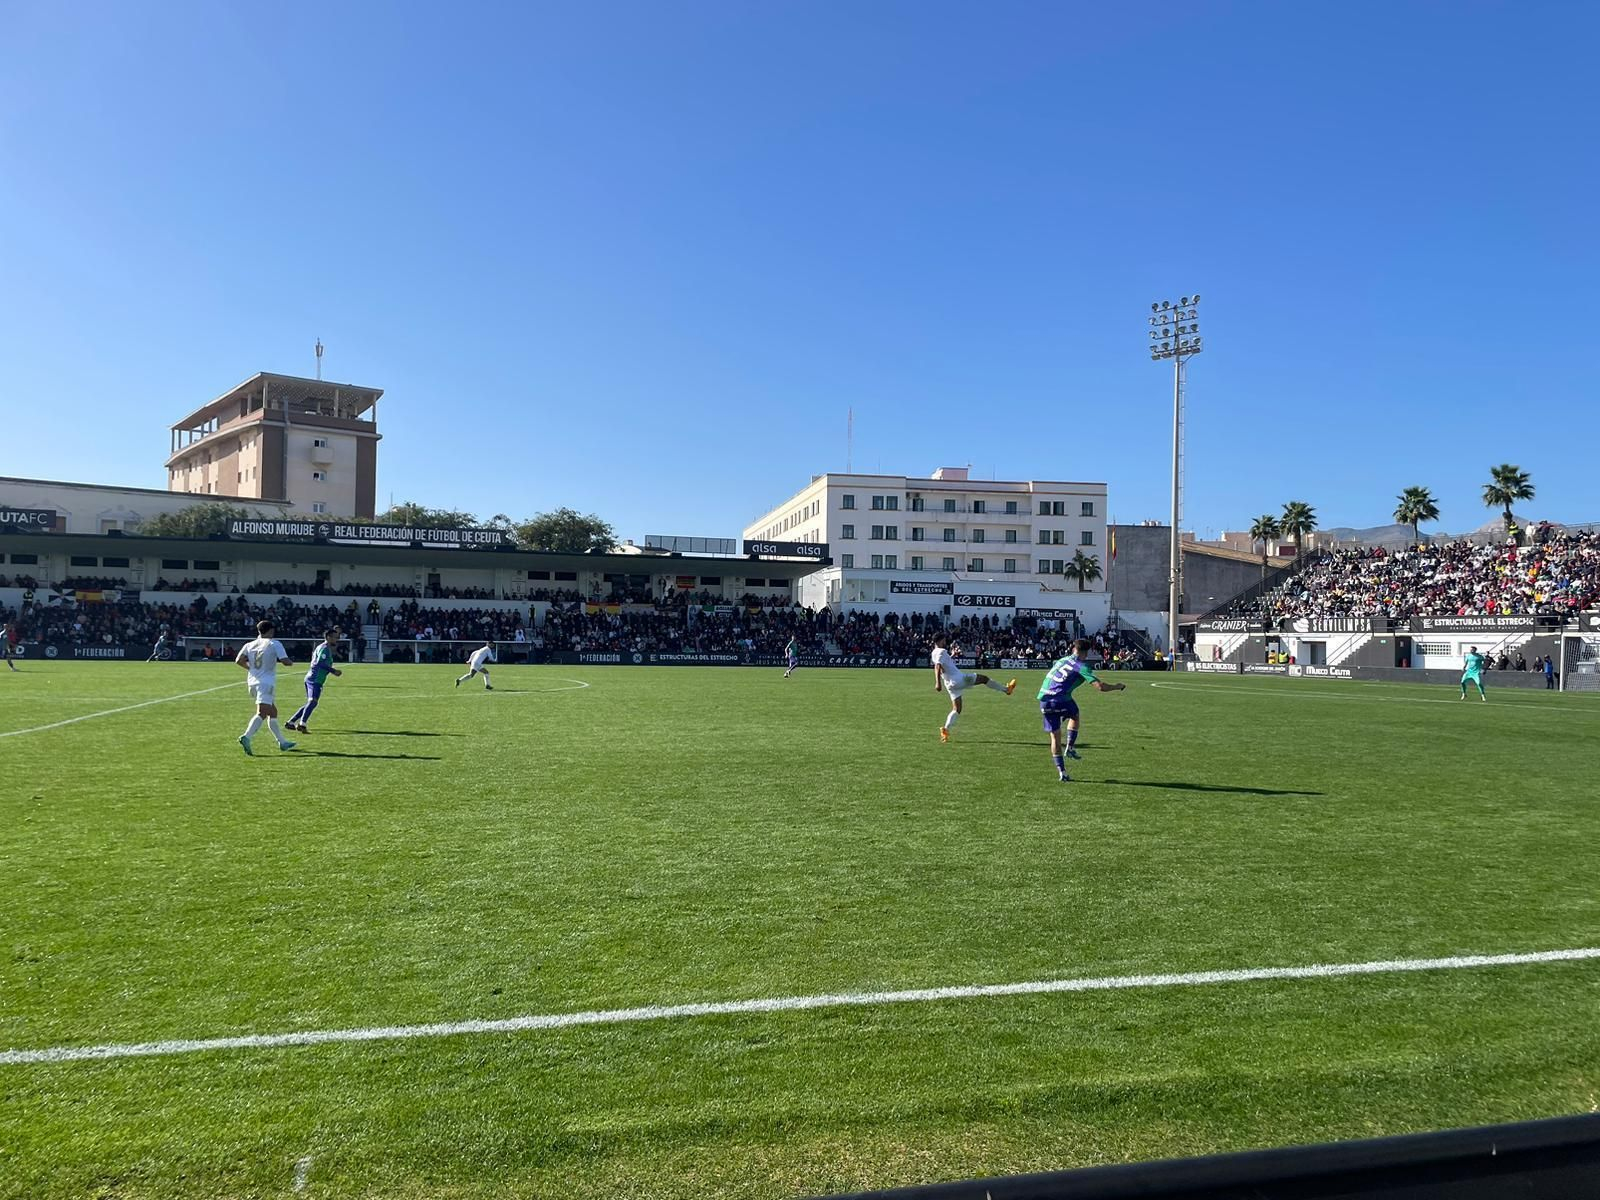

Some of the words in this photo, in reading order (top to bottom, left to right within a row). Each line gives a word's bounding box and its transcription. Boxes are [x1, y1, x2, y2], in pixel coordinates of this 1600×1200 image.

[232, 521, 274, 534] ALFONSO
[276, 523, 315, 535] MURUBE
[334, 525, 358, 537] REAL
[360, 525, 414, 540] FEDERACIÓN
[415, 528, 427, 540] DE
[428, 528, 460, 541] FÚTBOL
[462, 531, 474, 542] DE
[475, 532, 502, 544] CEUTA
[752, 543, 777, 553] alsa
[797, 545, 821, 555] alsa
[976, 596, 1011, 606] RTVCE
[1434, 618, 1481, 626] ESTRUCTURAS
[1482, 618, 1496, 626] DEL
[1052, 663, 1074, 683] 5
